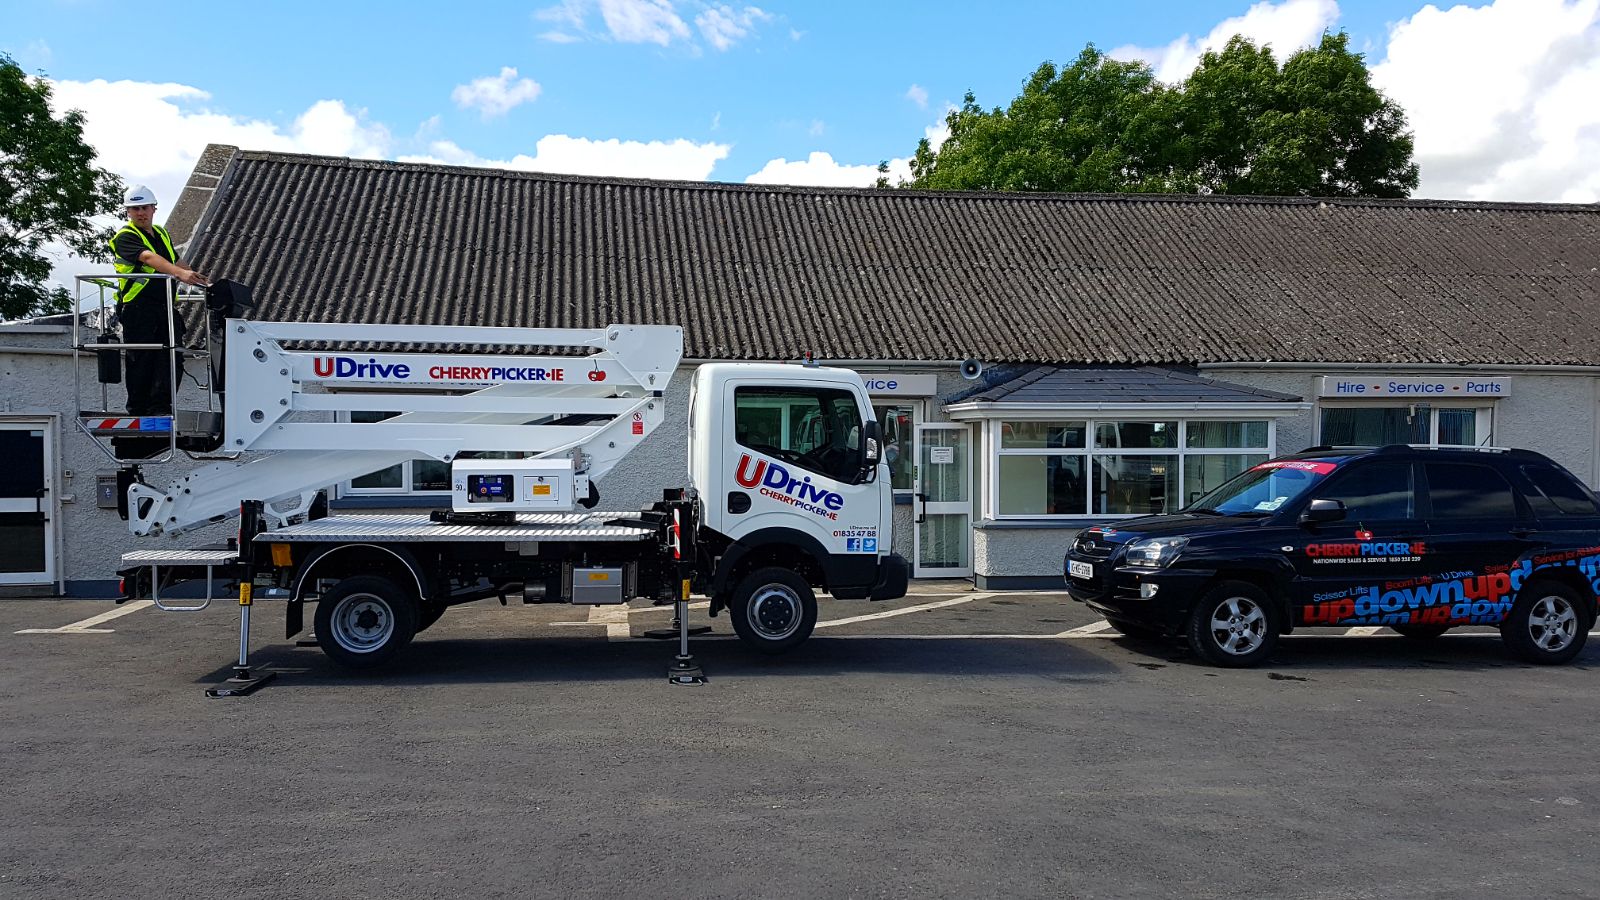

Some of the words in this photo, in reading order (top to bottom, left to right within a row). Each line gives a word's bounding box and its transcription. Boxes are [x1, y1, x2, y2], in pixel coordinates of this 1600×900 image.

[313, 356, 410, 379] UDrive
[1336, 381, 1366, 393] Hire
[1388, 381, 1445, 393] Service
[1466, 381, 1501, 393] Parts
[735, 452, 844, 511] UDrive
[1313, 589, 1348, 602] Scissor
[1349, 585, 1369, 596] Lifts
